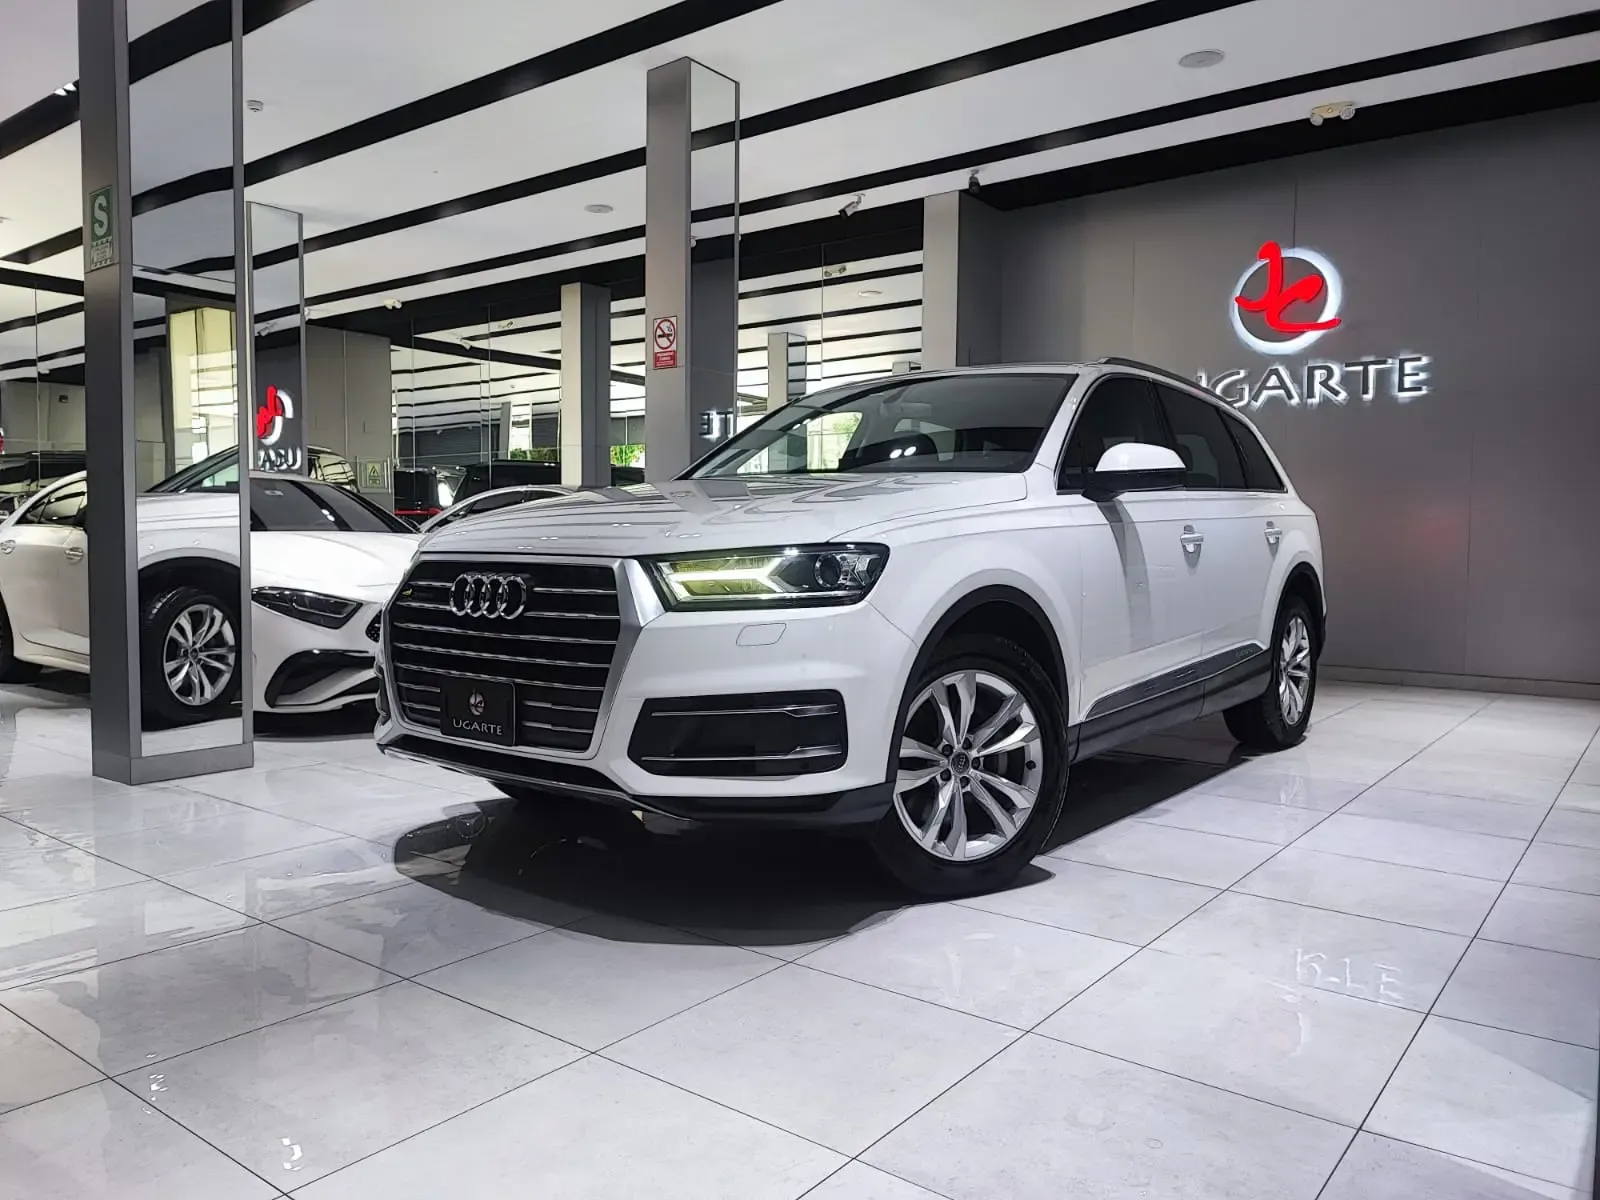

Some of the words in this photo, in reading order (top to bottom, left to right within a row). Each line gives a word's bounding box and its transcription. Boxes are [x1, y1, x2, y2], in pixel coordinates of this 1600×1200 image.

[94, 194, 109, 237] S
[1195, 354, 1431, 409] GARTE
[453, 718, 503, 736] UGARTE
